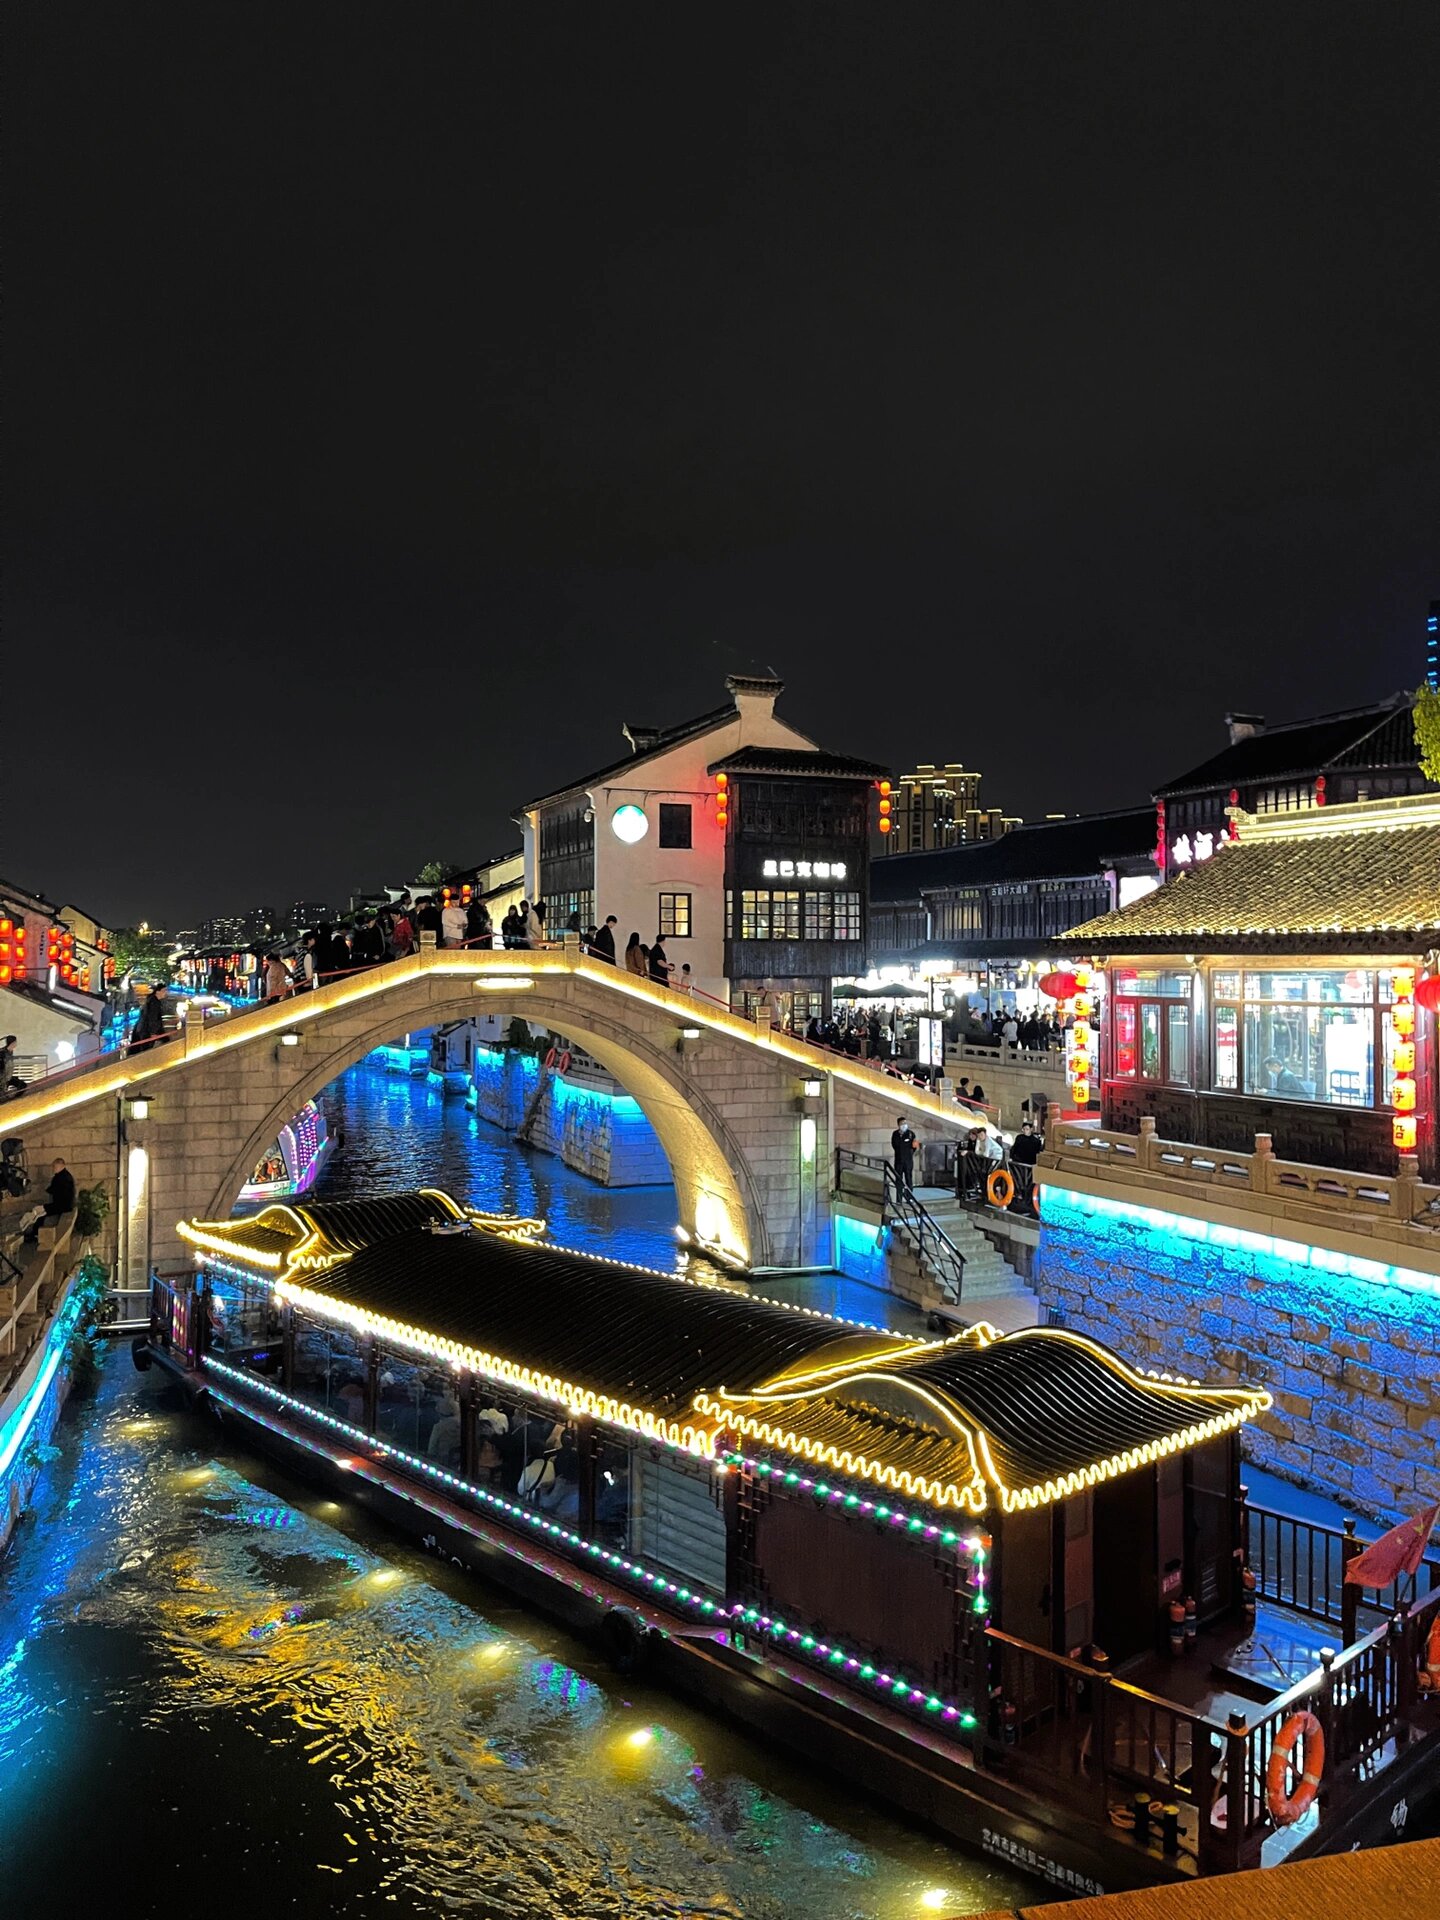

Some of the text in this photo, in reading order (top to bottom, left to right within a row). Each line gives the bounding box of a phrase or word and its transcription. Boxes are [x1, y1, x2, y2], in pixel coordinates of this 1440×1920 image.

[763, 860, 847, 879] 星巴克咖啡
